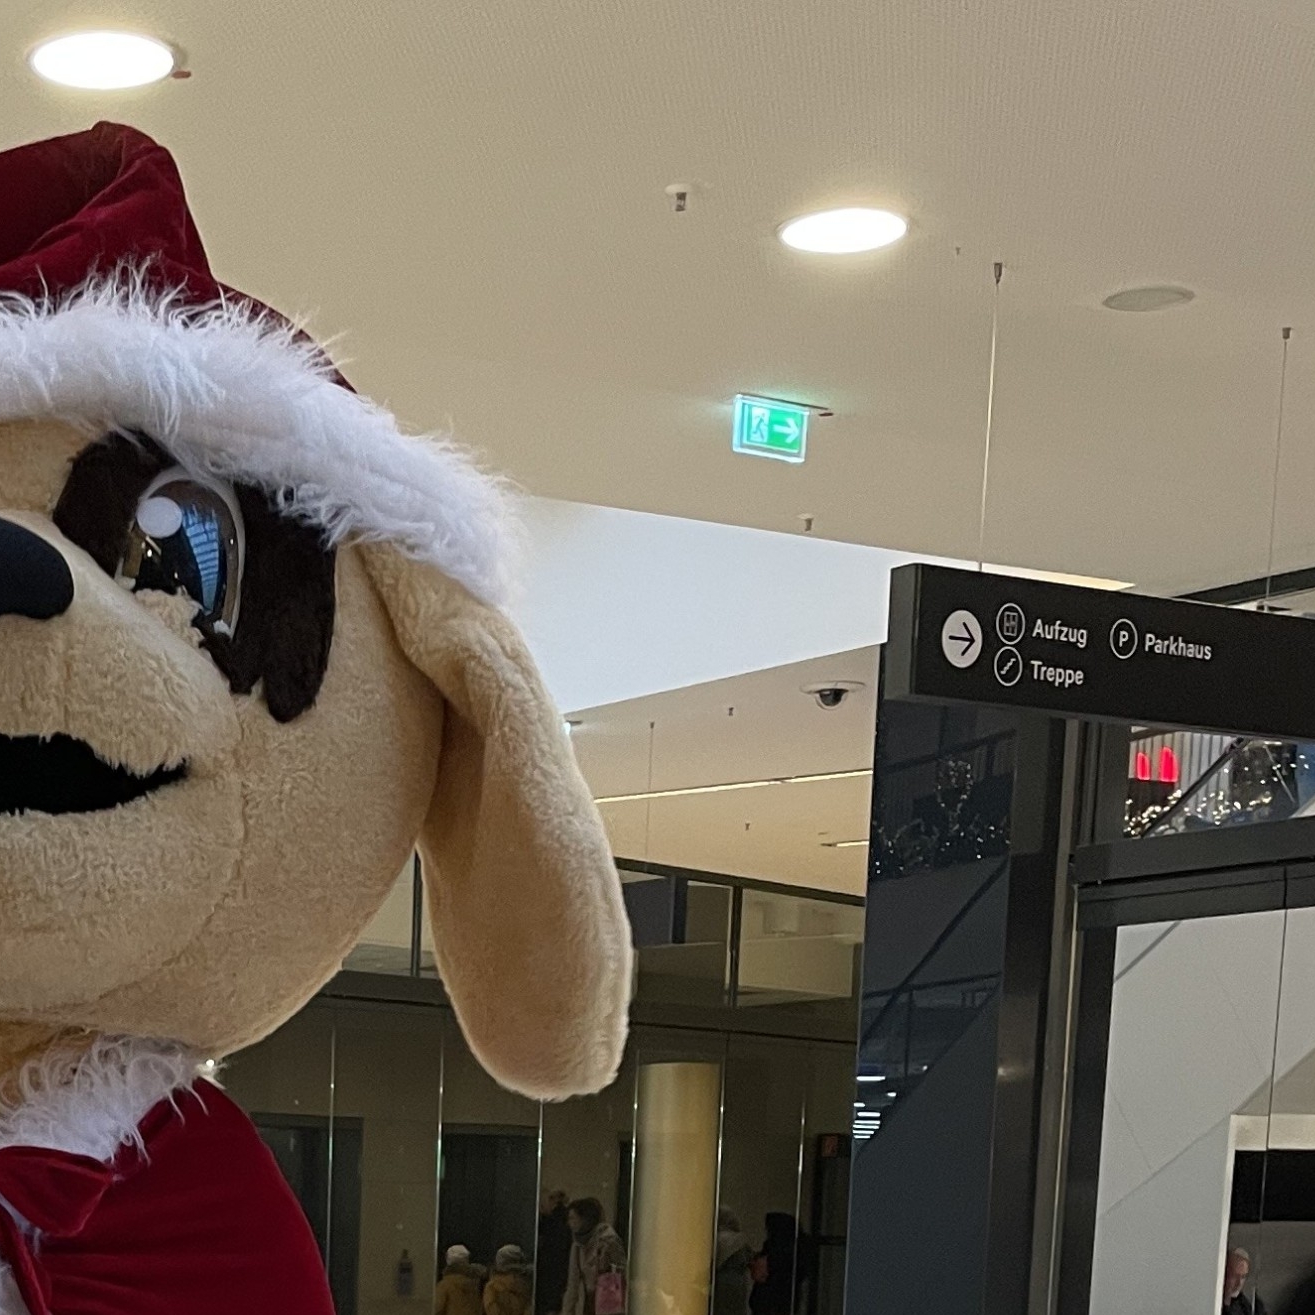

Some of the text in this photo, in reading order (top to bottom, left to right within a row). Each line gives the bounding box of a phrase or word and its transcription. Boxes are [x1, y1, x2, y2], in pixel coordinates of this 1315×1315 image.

[1032, 618, 1087, 648] Aufzug
[1118, 630, 1212, 660] P Parkhaus
[1030, 660, 1084, 688] Treppe
